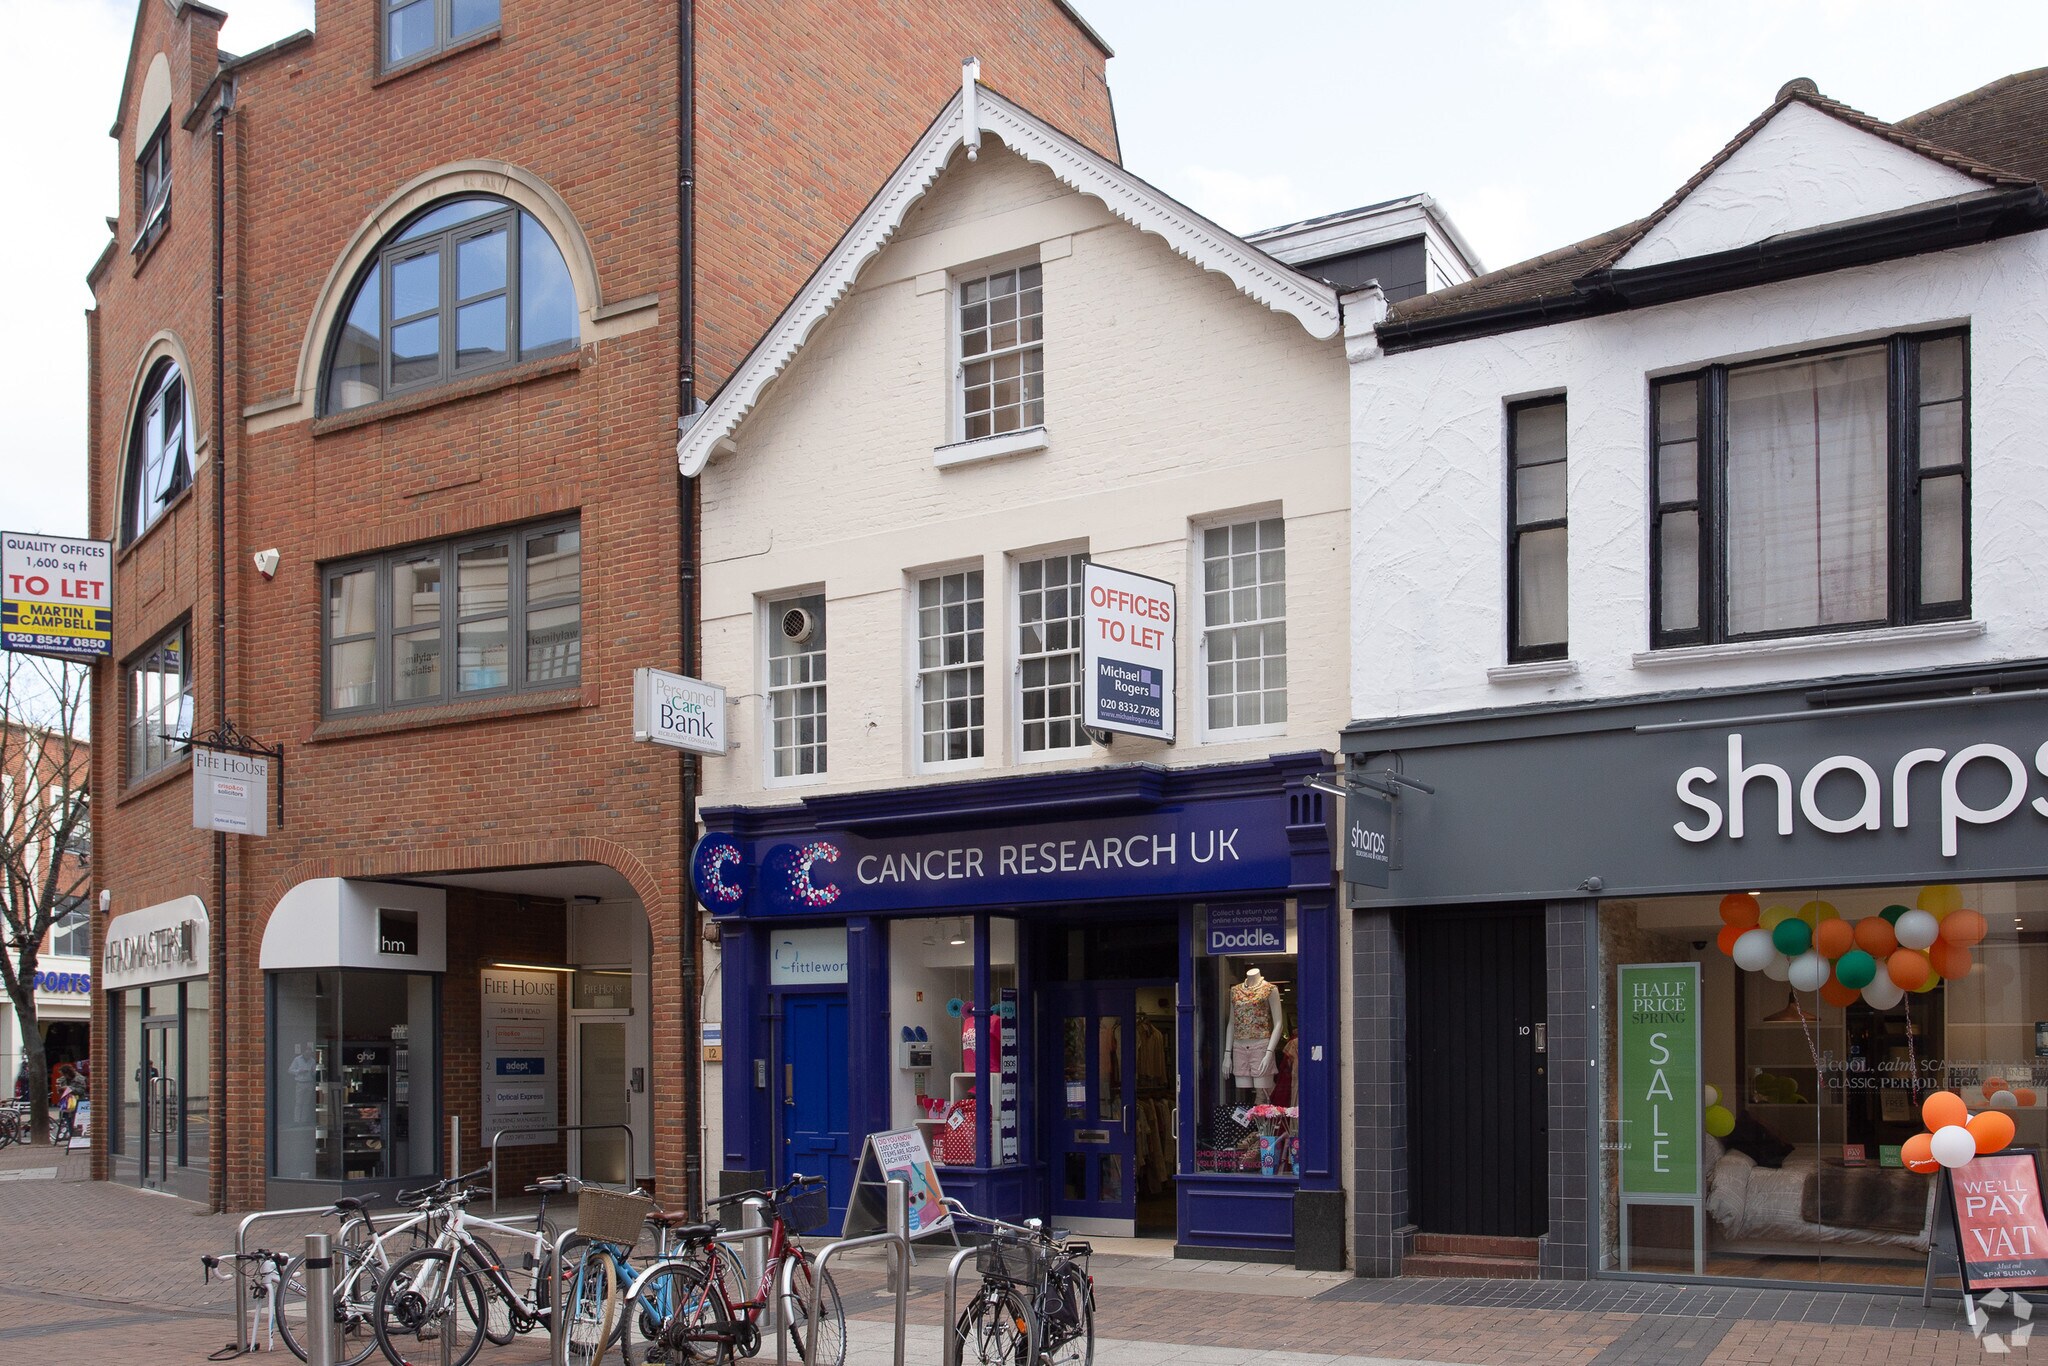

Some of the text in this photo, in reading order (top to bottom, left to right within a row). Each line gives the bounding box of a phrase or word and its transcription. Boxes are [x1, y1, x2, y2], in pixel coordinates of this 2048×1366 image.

[7, 539, 105, 557] QUALITY OFFICES
[26, 556, 88, 573] 1,600 sq ft
[9, 574, 104, 600] TO LET
[30, 604, 83, 618] MARTIN
[1090, 585, 1171, 623] OFFICES
[20, 615, 94, 630] CAMPBELL
[8, 633, 106, 648] 020 8547 0850
[1097, 617, 1165, 651] TO LET
[12, 642, 101, 653] www.martincampbell.co.uk
[1100, 664, 1140, 682] Michael
[656, 678, 717, 708] Personnel
[1115, 679, 1150, 697] Rogers
[671, 695, 702, 715] Care
[1100, 698, 1160, 718] 020 8332 7788
[660, 703, 714, 739] Bank
[1100, 710, 1160, 726] www.michaelrogers.co.uk
[196, 753, 266, 776] FIFE HOUSE
[217, 789, 244, 797] solicitors
[1351, 820, 1385, 860] sharps
[856, 847, 984, 885] CANCER
[999, 832, 1176, 876] RESEARCH
[1190, 828, 1239, 863] UK
[1211, 909, 1234, 917] Collect
[1232, 915, 1262, 924] shopping
[105, 927, 182, 974] HEADMASTERS
[381, 935, 405, 952] hm
[34, 971, 91, 993] PORTS
[484, 977, 556, 996] FIFE HOUSE
[1633, 982, 1687, 998] HALF
[1633, 998, 1687, 1012] PRICE
[1632, 1012, 1686, 1025] SPRING
[1518, 1026, 1530, 1035] 10
[356, 1051, 376, 1063] ghd
[708, 1048, 717, 1058] 12
[505, 1060, 529, 1071] adept
[1828, 1060, 1874, 1073] COOL,
[1828, 1078, 1878, 1090] CLASSIC,
[497, 1093, 519, 1101] Optical
[520, 1093, 544, 1101] Express
[1646, 1032, 1674, 1173] SALE
[878, 1133, 912, 1145] DID YOU KNOW
[893, 1142, 901, 1150] OF
[882, 1149, 896, 1158] ITEMS
[905, 1145, 921, 1154] ADDED
[884, 1157, 898, 1165] EACH
[1963, 1180, 2028, 1194] WE'LL
[1965, 1194, 2029, 1218] PAY
[1970, 1226, 2037, 1257] VAT
[1983, 1269, 2037, 1278] 4PM SUNDAY
